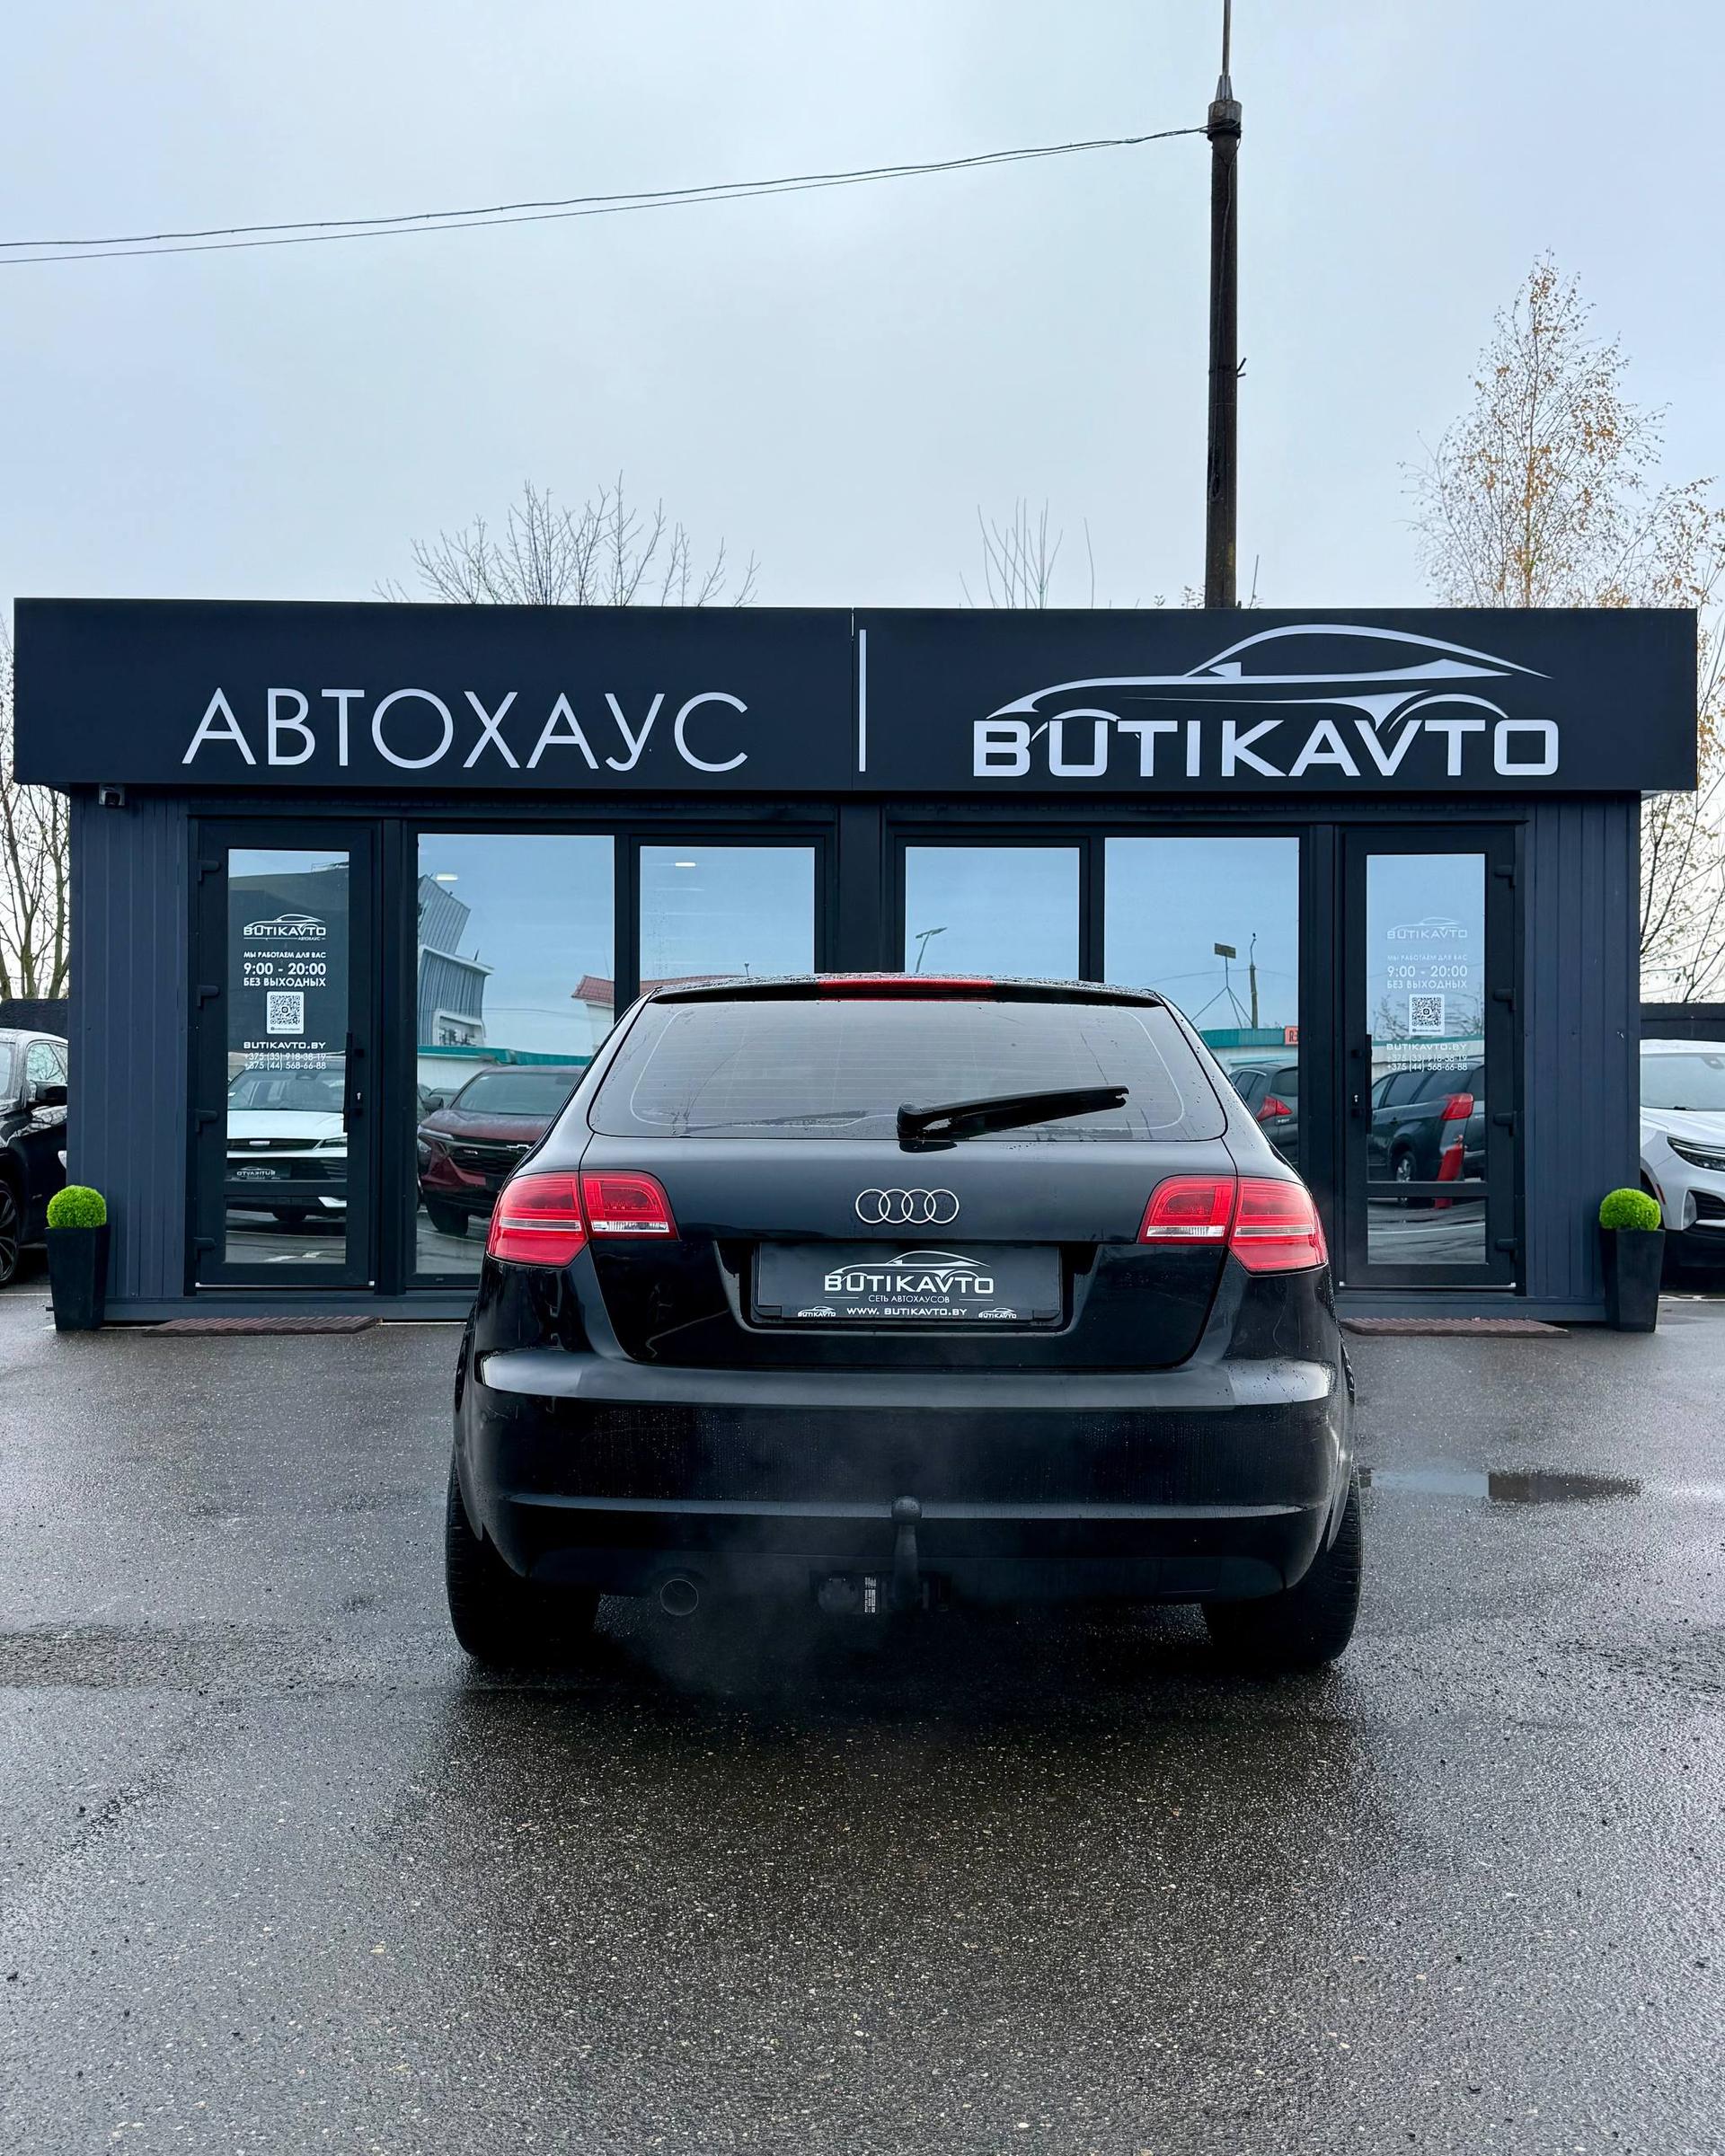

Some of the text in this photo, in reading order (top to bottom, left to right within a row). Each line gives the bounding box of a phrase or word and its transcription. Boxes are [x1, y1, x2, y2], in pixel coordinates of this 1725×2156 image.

[181, 686, 748, 773] АВТОХАУС
[972, 719, 1560, 778] BUTIKAVTO
[243, 926, 326, 936] BUTIKAVTO
[1386, 930, 1467, 940] BUTIKAVTO
[243, 963, 273, 976] 9:00
[288, 963, 326, 976] 20:00
[1387, 966, 1415, 977] 9:00
[1430, 965, 1467, 977] 20:00
[243, 977, 326, 987] БЕЗ ВЫХОДНЫХ
[1387, 980, 1467, 989] БЕЗ ВЫХОДНЫХ
[267, 1061, 283, 1071] (44)
[286, 1062, 326, 1070] 568-66-88
[1386, 1063, 1468, 1072] +375 (44) 568-66-88
[824, 1274, 994, 1294] BUTIKAVTO
[868, 1294, 951, 1303] СЕТЬ АВТОХАУСОВ
[846, 1307, 968, 1316] WWW. BUTIKAVTO.BY
